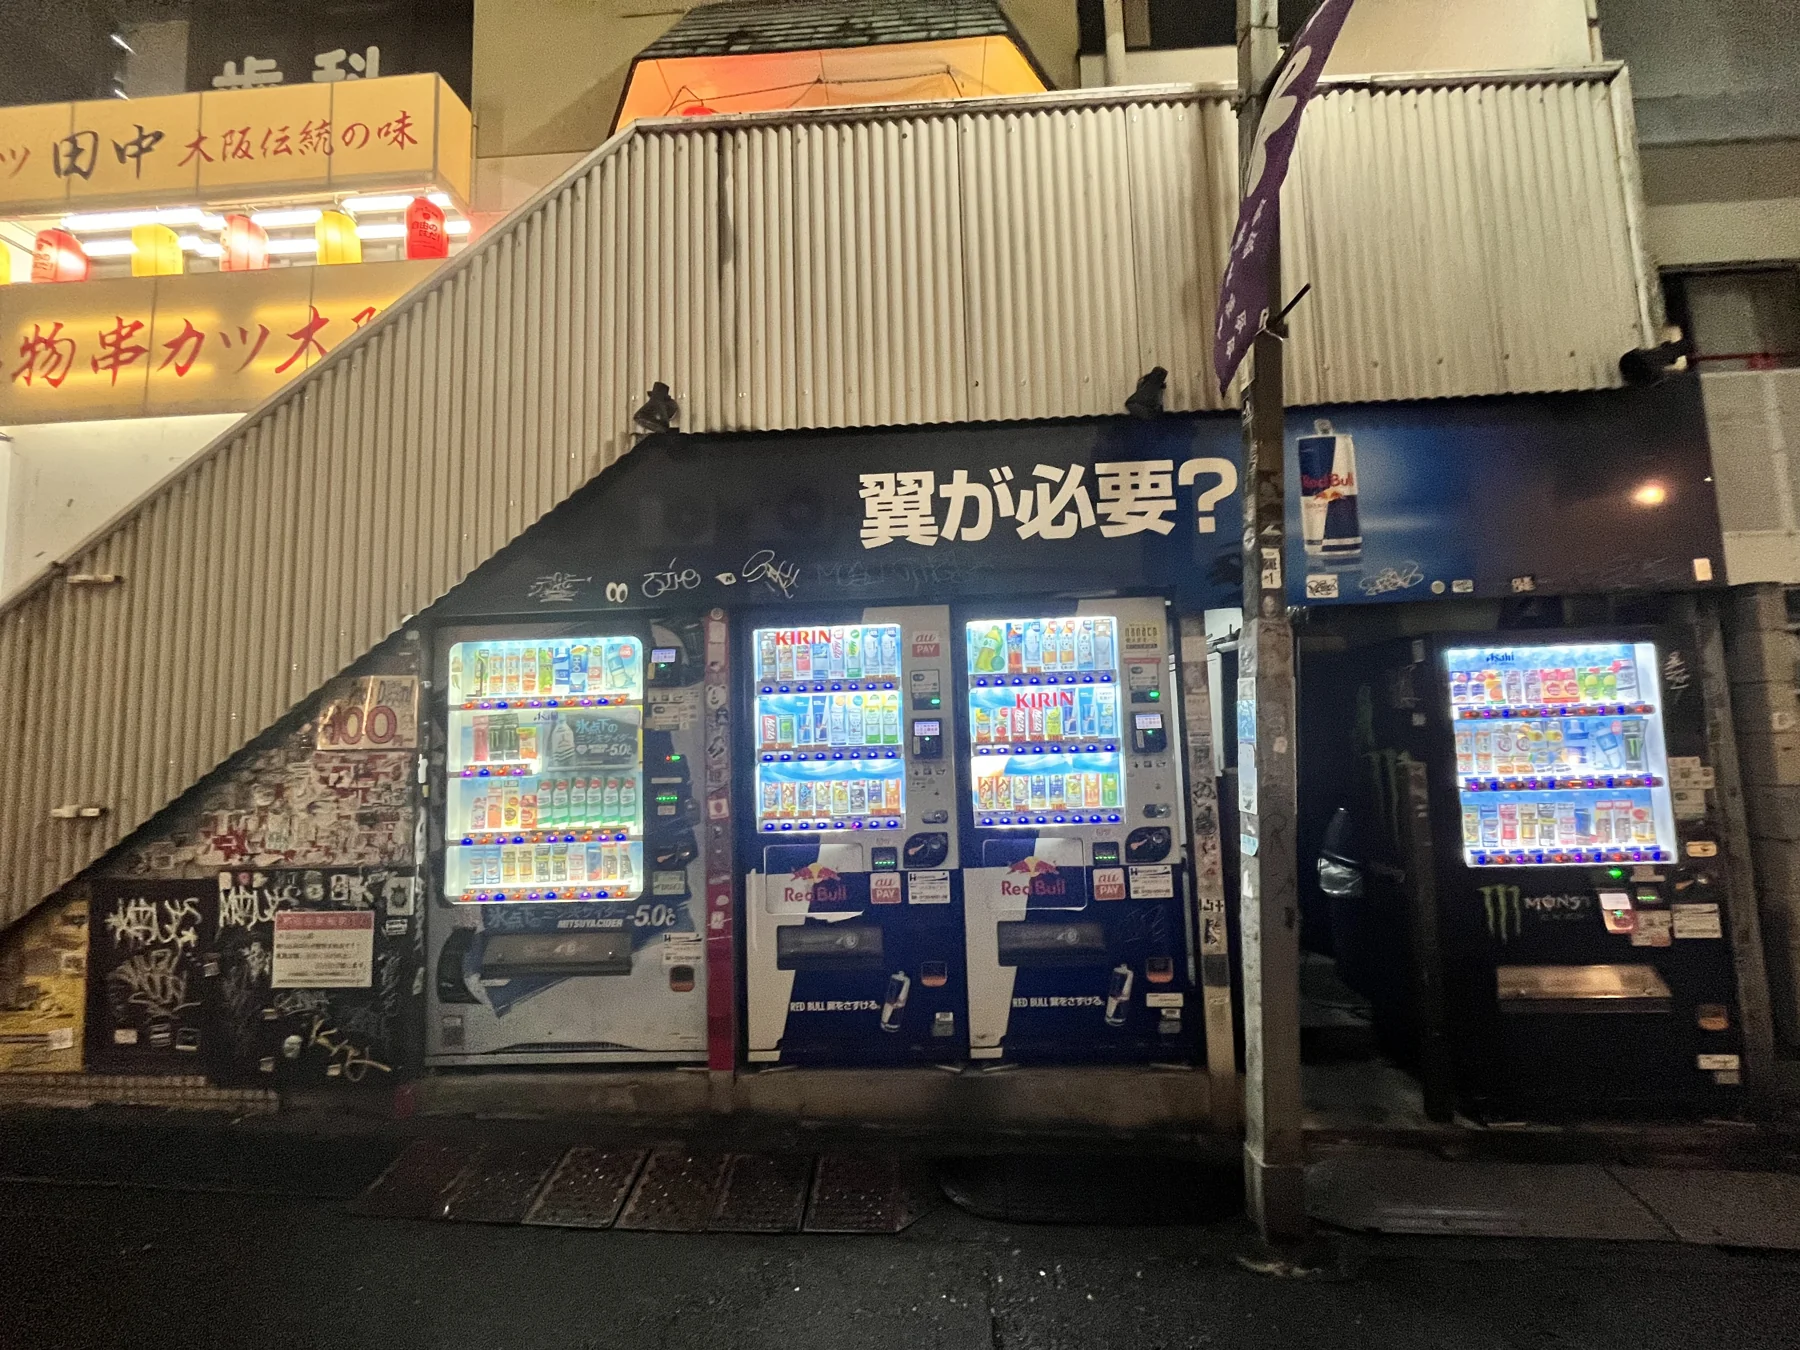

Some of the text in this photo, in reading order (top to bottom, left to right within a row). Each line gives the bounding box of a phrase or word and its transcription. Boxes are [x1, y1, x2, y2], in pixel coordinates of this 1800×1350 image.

[177, 110, 418, 168] 大阪伝統の味
[859, 457, 1238, 549] 翼が必要？
[775, 629, 831, 645] KIRIN
[917, 645, 936, 653] PAY
[1486, 653, 1515, 661] Asahi
[1015, 692, 1074, 708] KIRIN
[784, 887, 813, 901] Red
[876, 889, 895, 898] PAY
[1001, 881, 1031, 895] Red
[1100, 885, 1119, 894] PAY
[790, 1002, 805, 1012] RED
[807, 1001, 825, 1011] BULL
